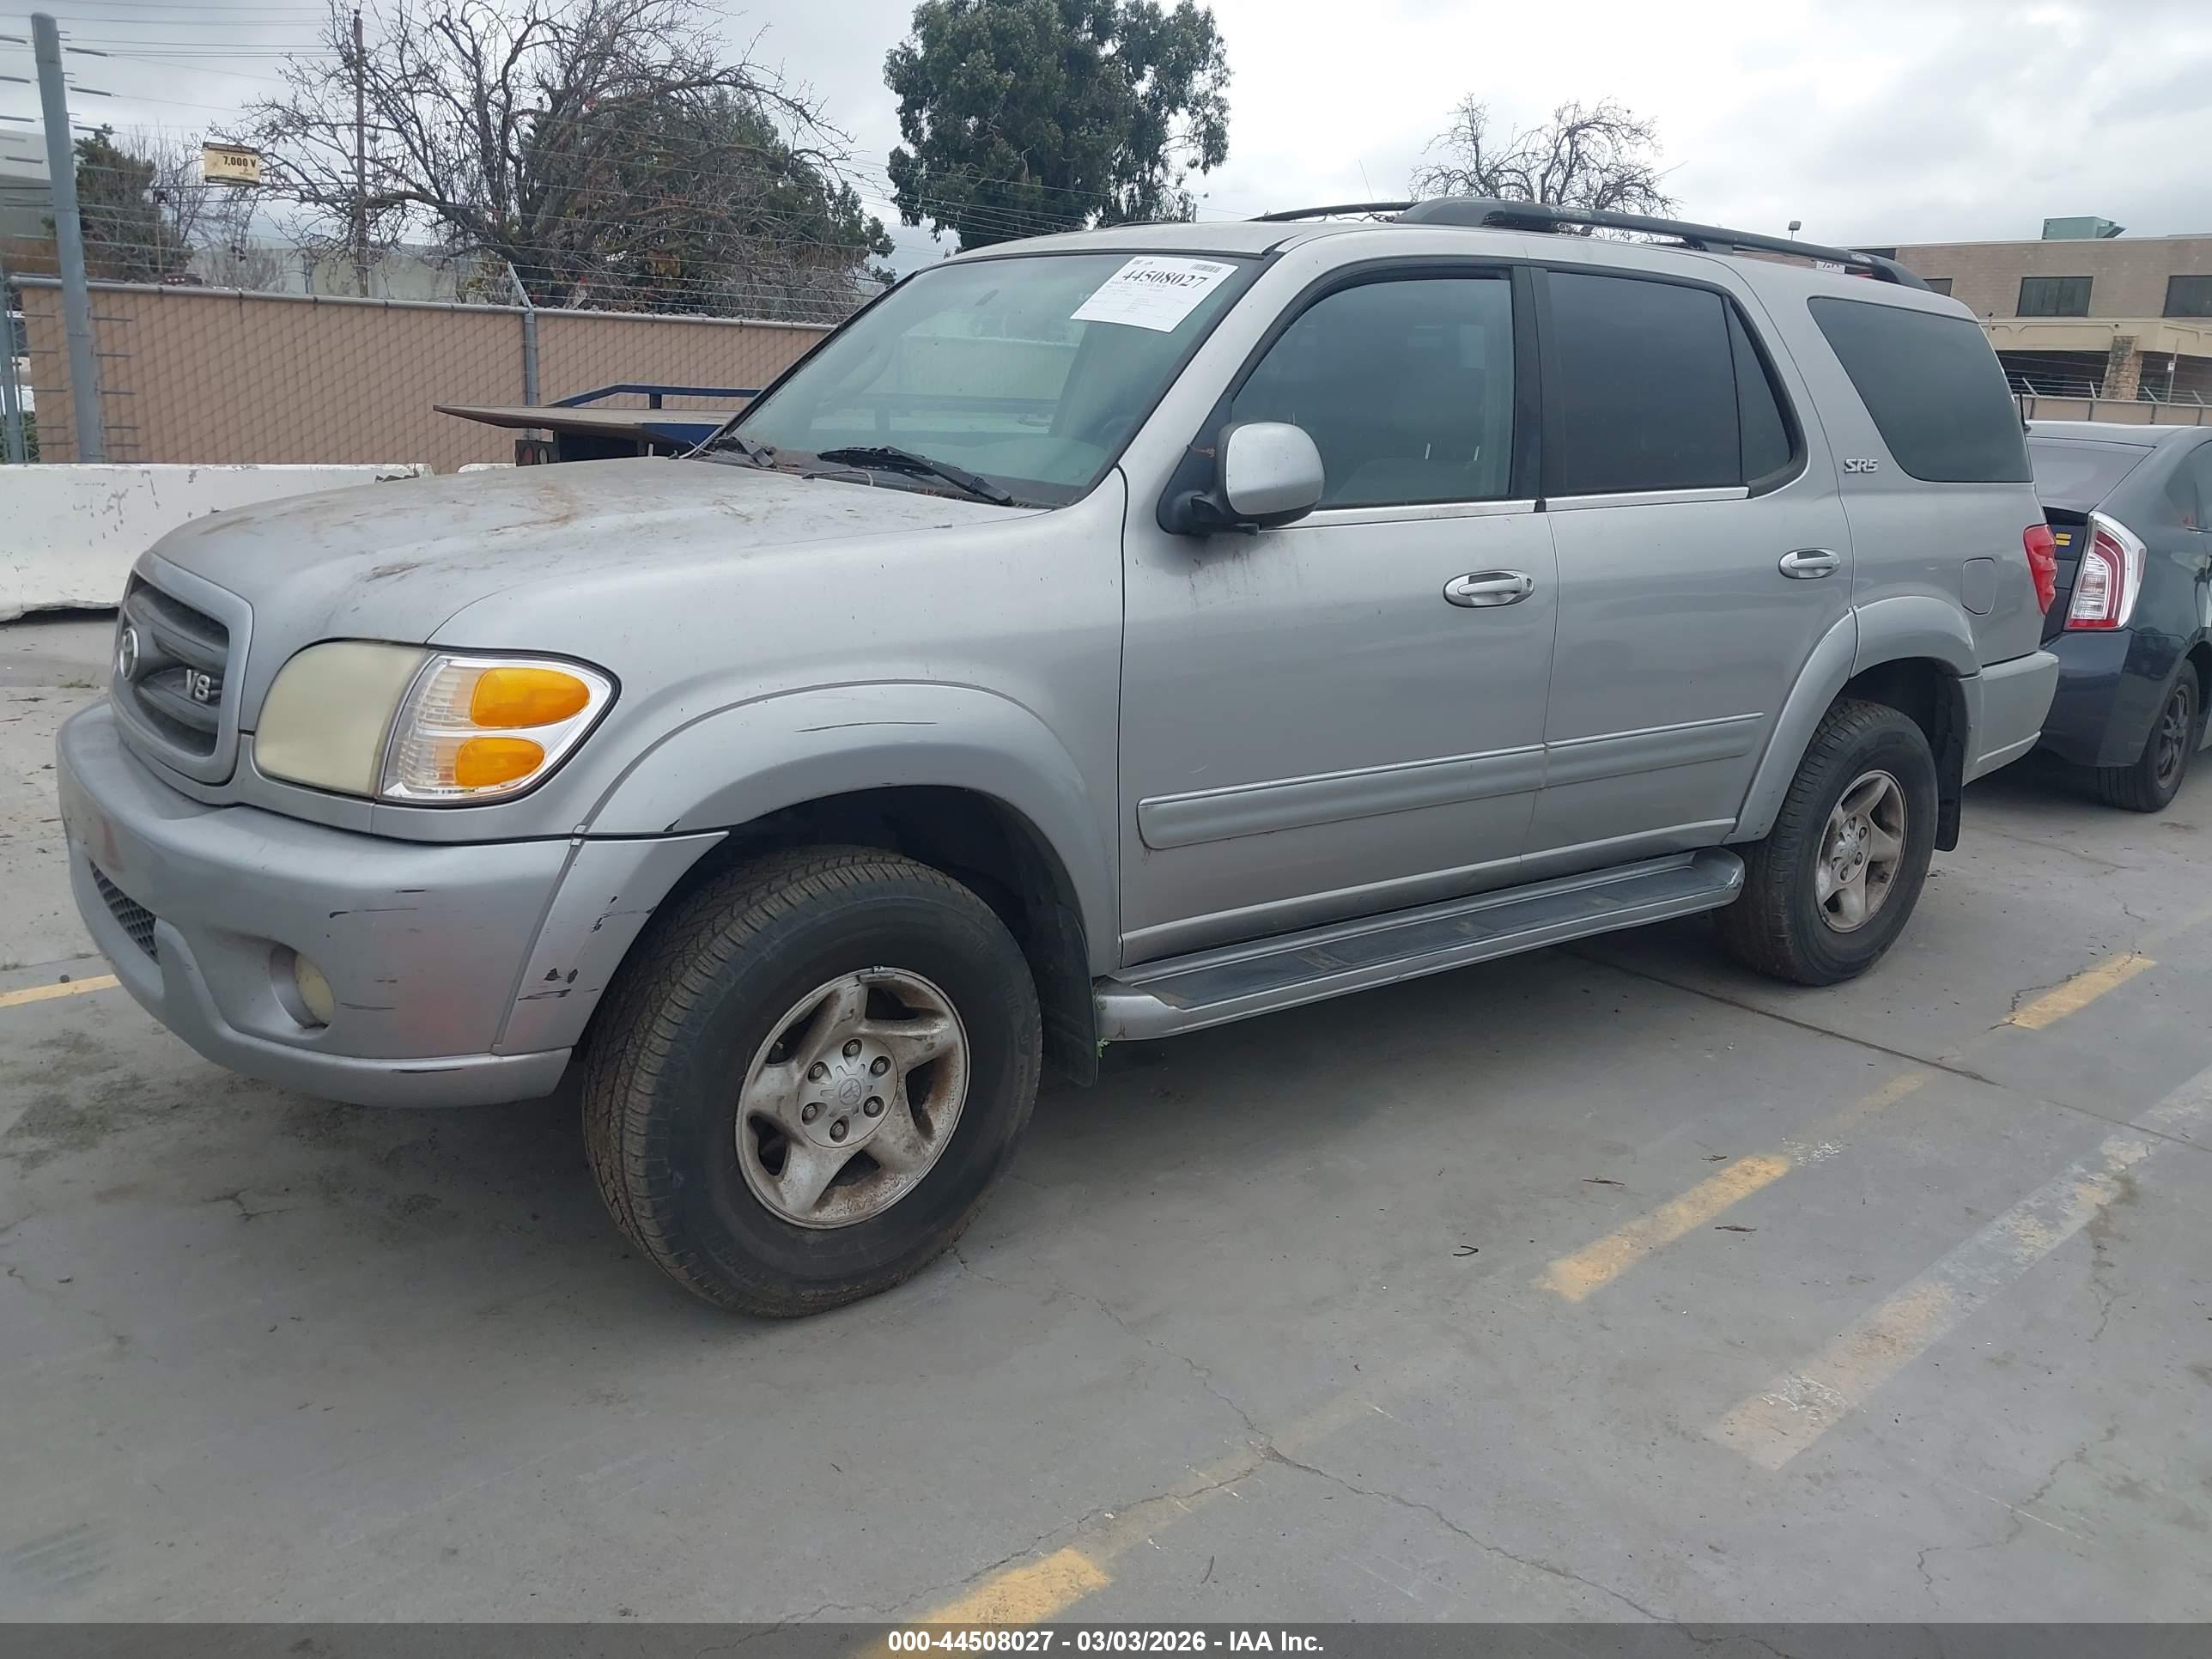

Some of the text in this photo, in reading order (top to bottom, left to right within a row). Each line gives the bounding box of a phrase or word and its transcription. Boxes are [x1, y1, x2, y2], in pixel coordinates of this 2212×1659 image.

[222, 155, 257, 168] 7,000 V
[1122, 269, 1209, 289] 44508027
[185, 668, 211, 702] V8
